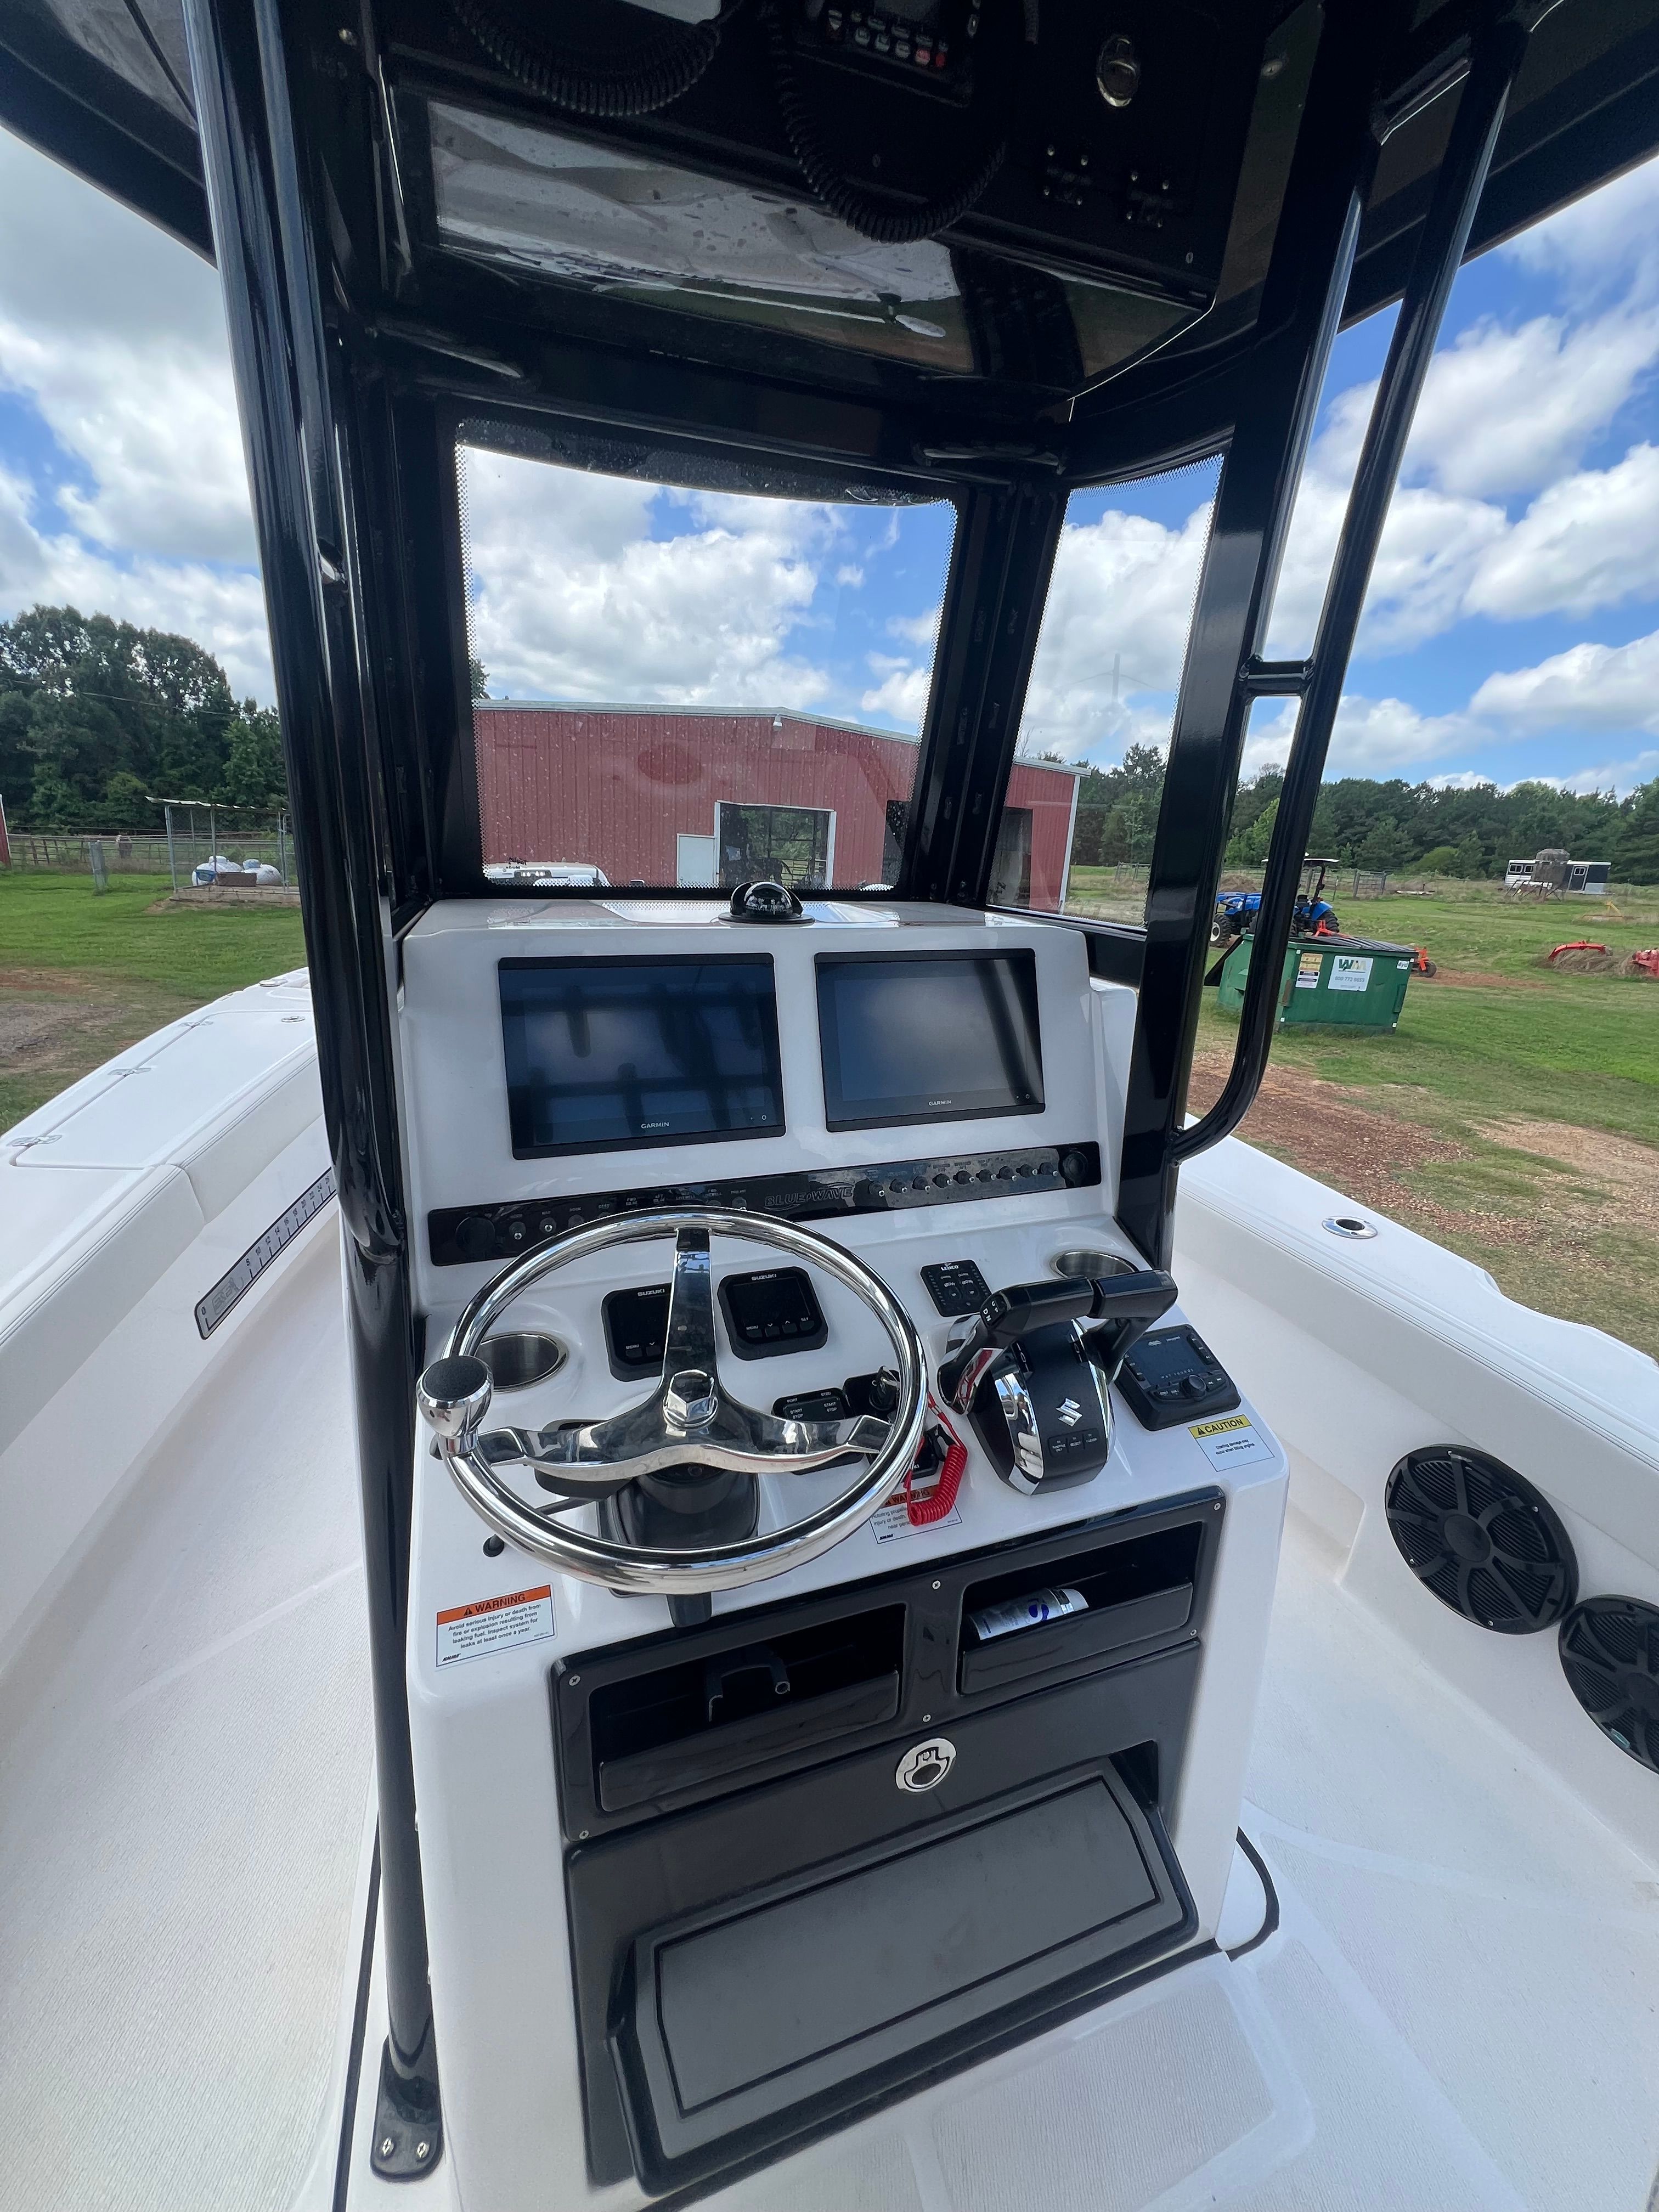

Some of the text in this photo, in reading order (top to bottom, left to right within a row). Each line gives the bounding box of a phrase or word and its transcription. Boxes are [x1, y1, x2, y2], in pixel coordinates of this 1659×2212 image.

[1339, 959, 1366, 970] WM
[246, 1258, 250, 1266] 8
[201, 1306, 206, 1315] 0
[1205, 1418, 1244, 1433] CAUTION
[475, 1594, 526, 1613] WARNING
[448, 1623, 465, 1632] Avoid
[466, 1618, 487, 1627] serious
[471, 1622, 498, 1632] explosion
[499, 1615, 523, 1625] resulting
[452, 1635, 473, 1644] leaking
[509, 1620, 529, 1629] system
[460, 1641, 476, 1649] leaks
